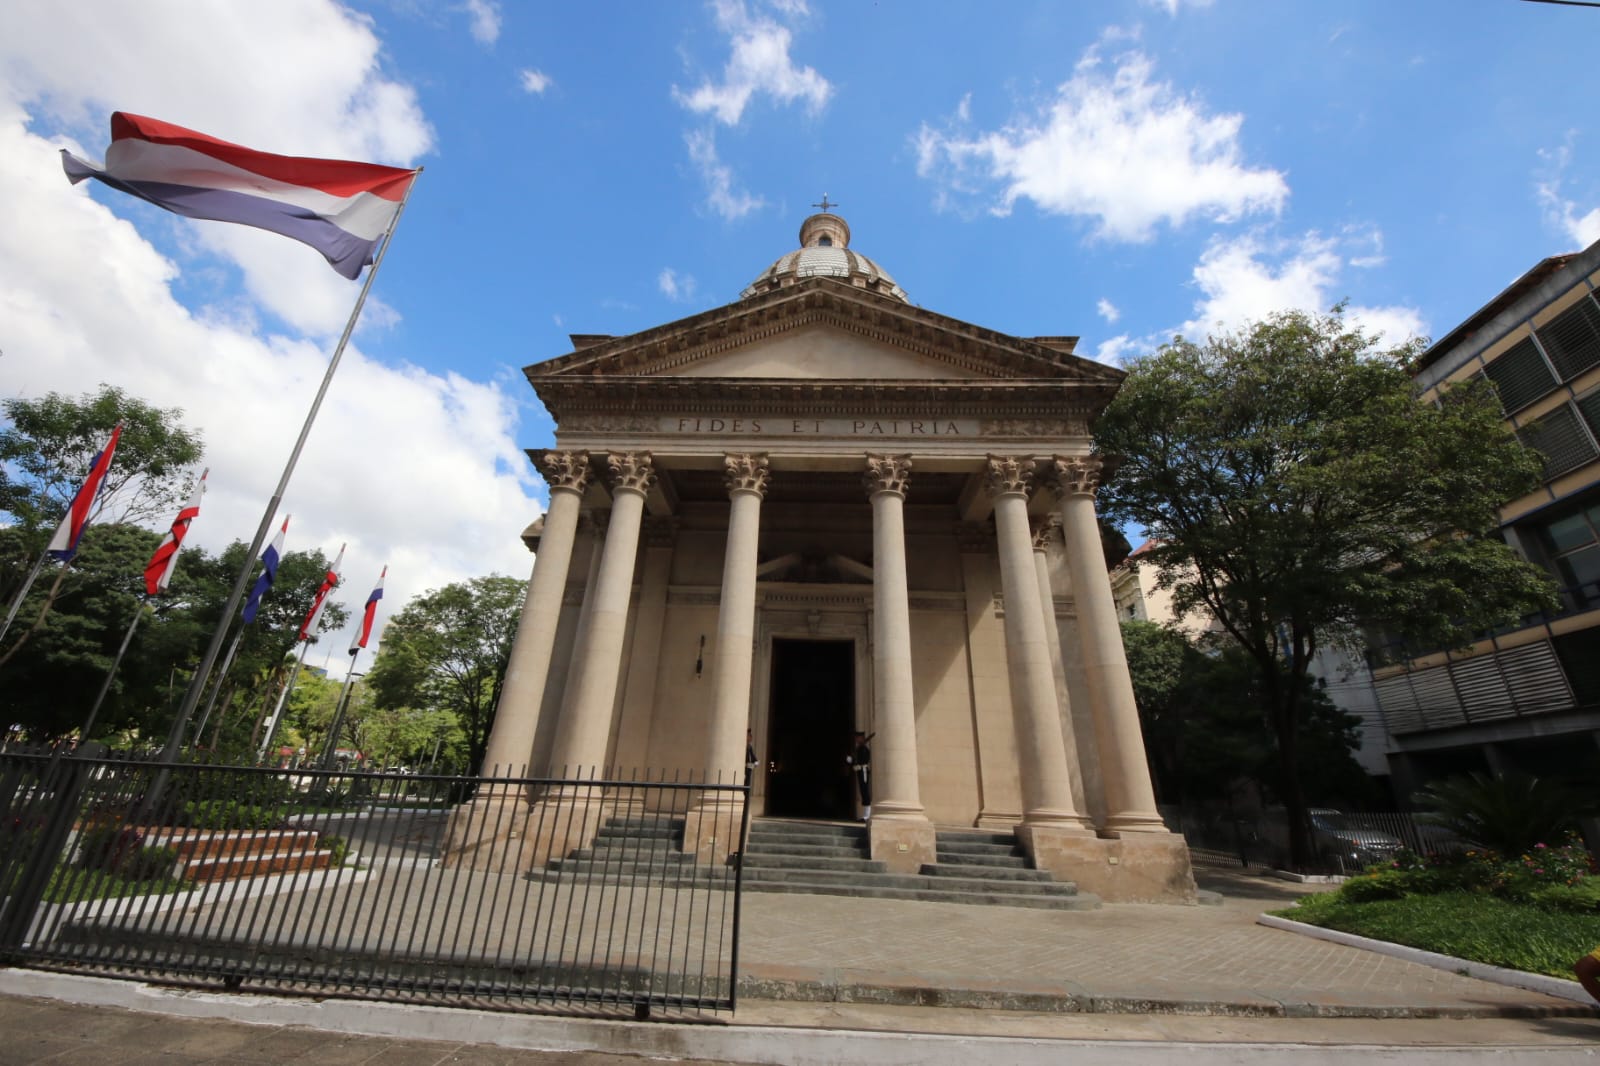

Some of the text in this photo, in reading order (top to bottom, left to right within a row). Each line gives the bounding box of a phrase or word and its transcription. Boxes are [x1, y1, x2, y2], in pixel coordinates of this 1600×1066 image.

[678, 418, 960, 434] FIDES ET PATRIA
